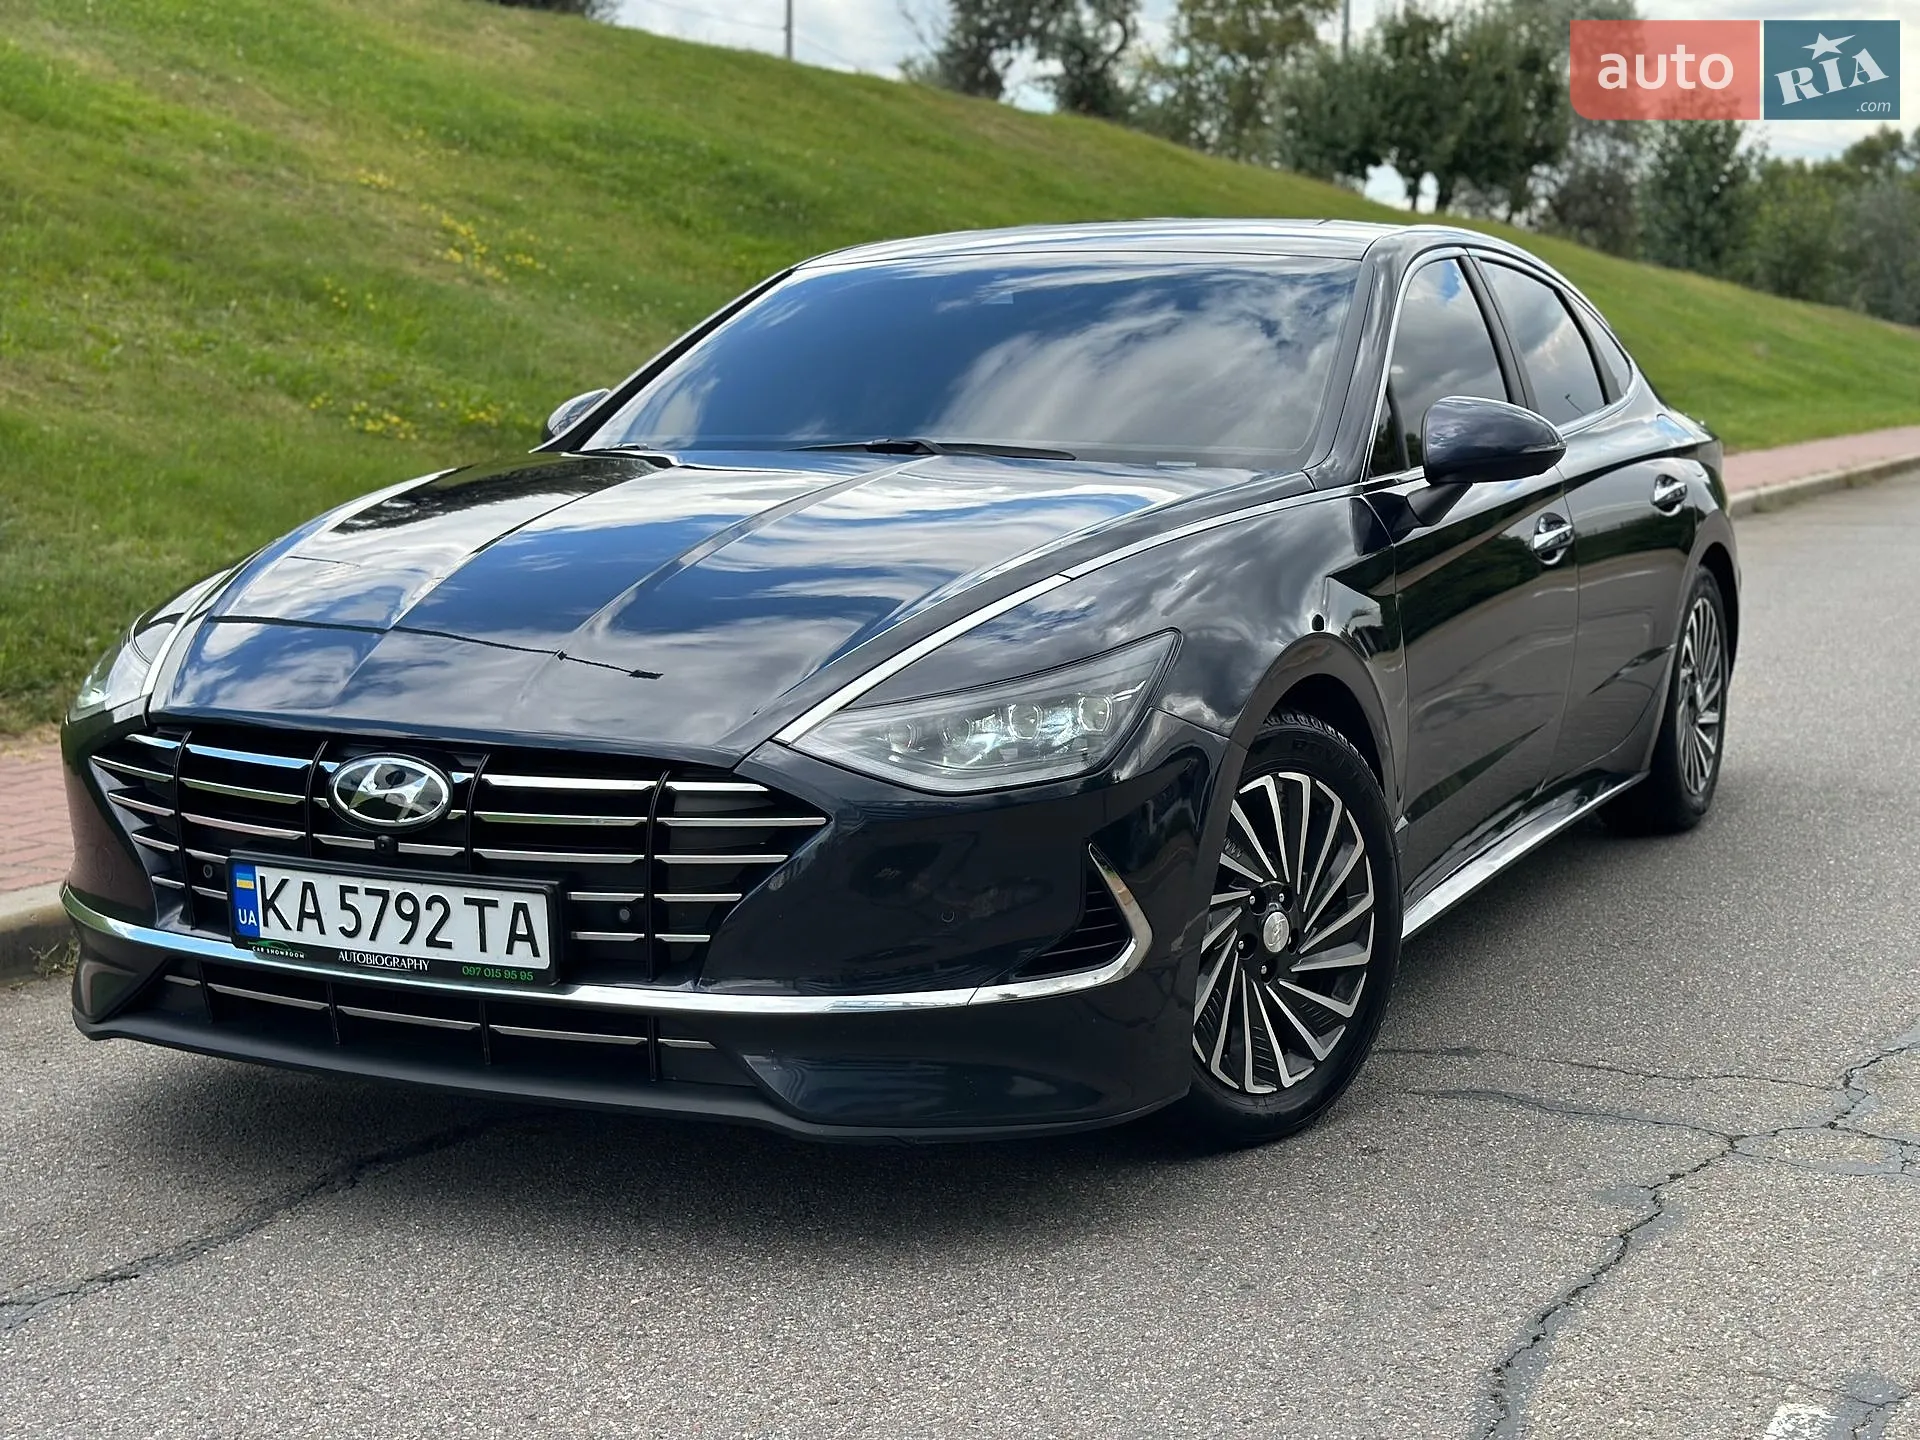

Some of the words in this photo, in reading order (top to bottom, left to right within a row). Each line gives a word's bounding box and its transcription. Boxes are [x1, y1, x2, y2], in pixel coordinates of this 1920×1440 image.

[238, 909, 257, 927] UA
[259, 875, 326, 935] KA
[339, 885, 453, 949] 5792
[464, 896, 540, 958] TA
[338, 951, 430, 971] AUTOBIOGRAPHY
[462, 965, 481, 976] 097
[483, 968, 502, 979] 015
[504, 969, 518, 980] 95
[520, 971, 534, 981] 95
